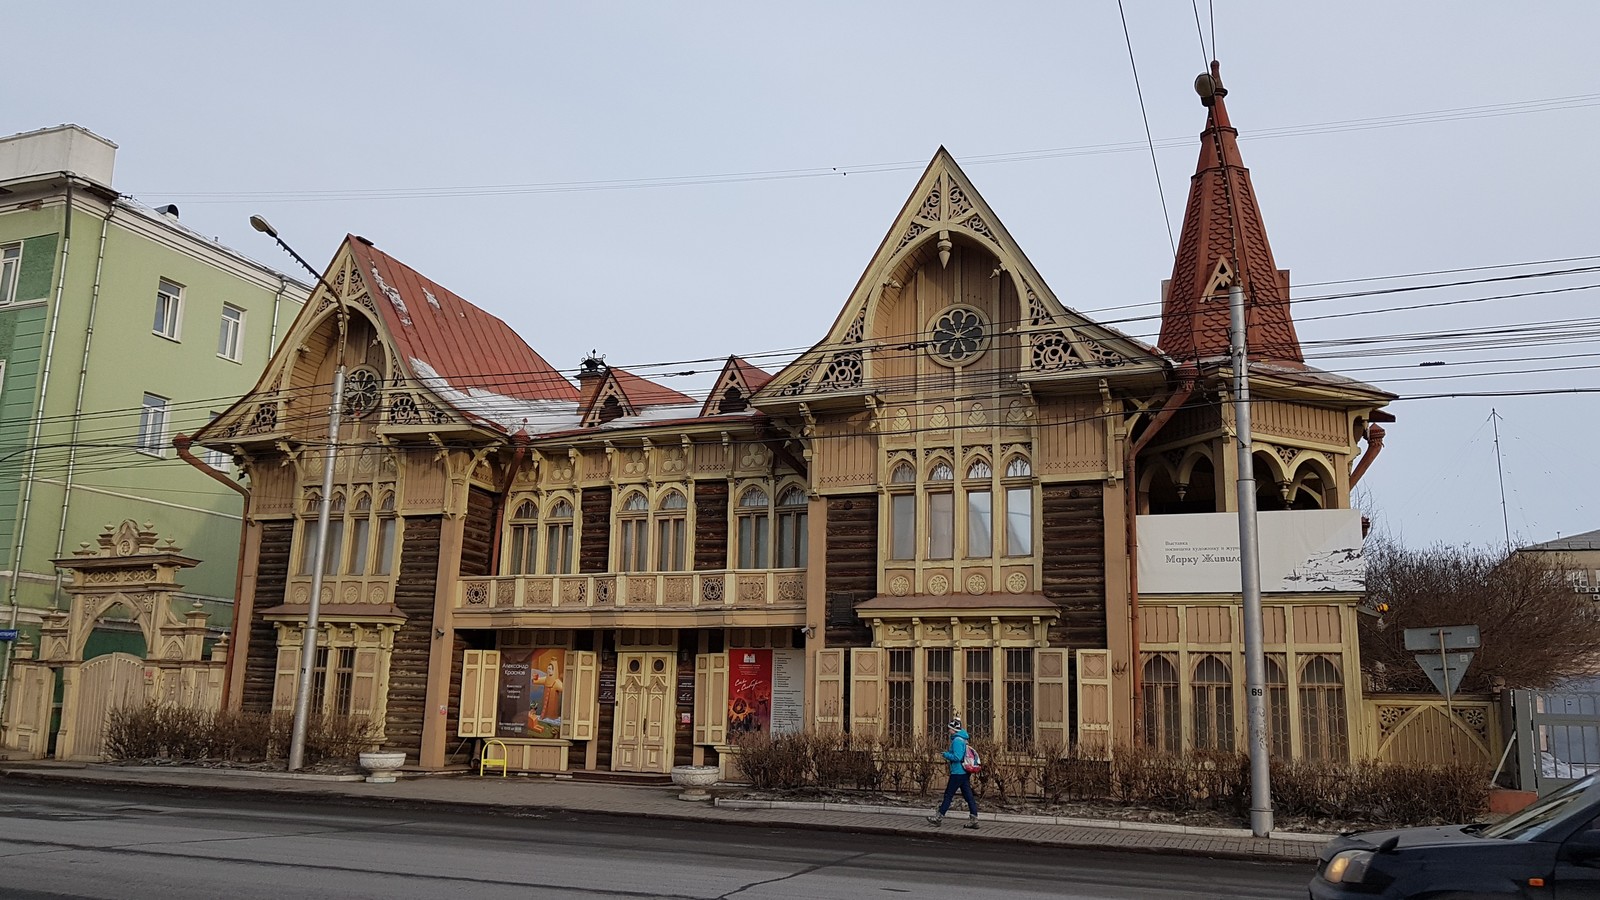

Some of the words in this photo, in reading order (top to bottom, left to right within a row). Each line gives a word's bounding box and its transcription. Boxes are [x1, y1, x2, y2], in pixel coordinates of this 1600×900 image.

[1165, 554, 1199, 566] Марку
[501, 662, 529, 670] Александр
[1252, 688, 1262, 696] 69
